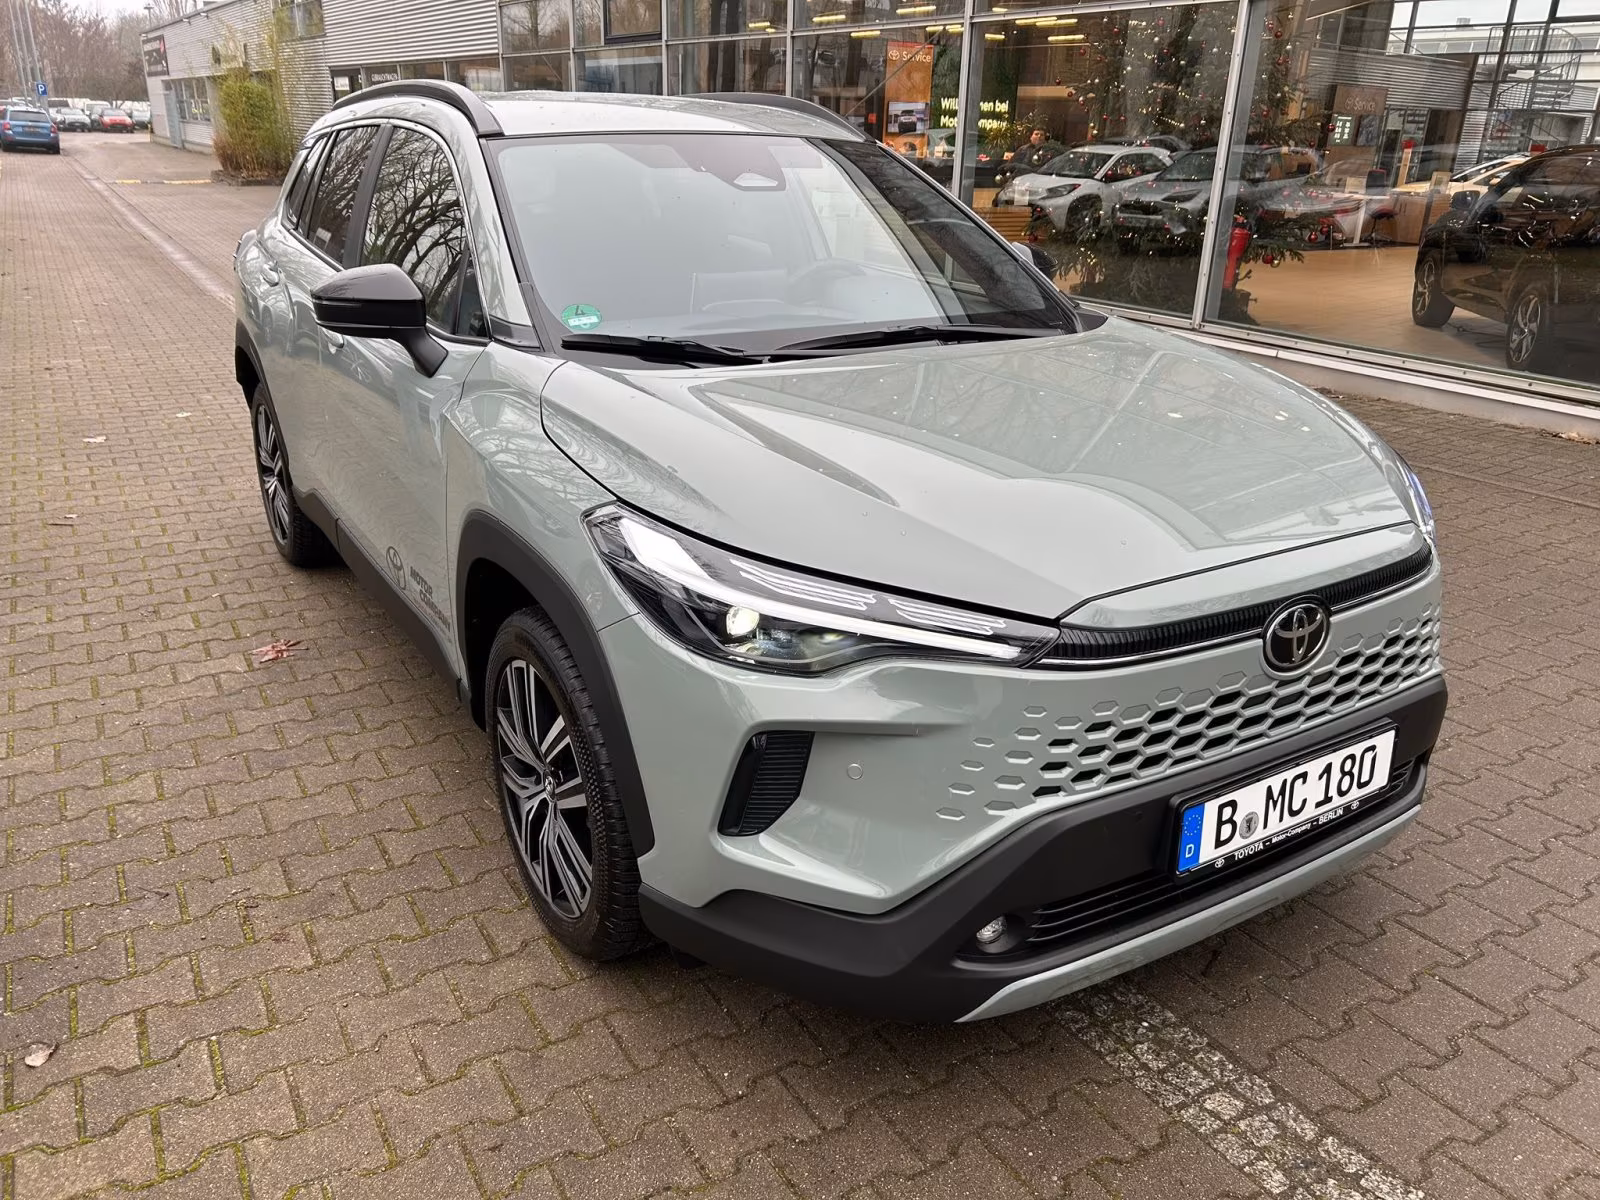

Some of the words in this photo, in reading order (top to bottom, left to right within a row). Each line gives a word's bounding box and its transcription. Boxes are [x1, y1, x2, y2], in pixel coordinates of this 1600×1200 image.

[902, 51, 932, 62] Service
[38, 84, 45, 95] P
[1214, 799, 1238, 850] B
[1263, 770, 1309, 830] MC
[1315, 744, 1378, 810] 180
[1234, 841, 1264, 861] TOYOTA
[1318, 807, 1344, 825] BERLIN
[1185, 844, 1195, 859] D
